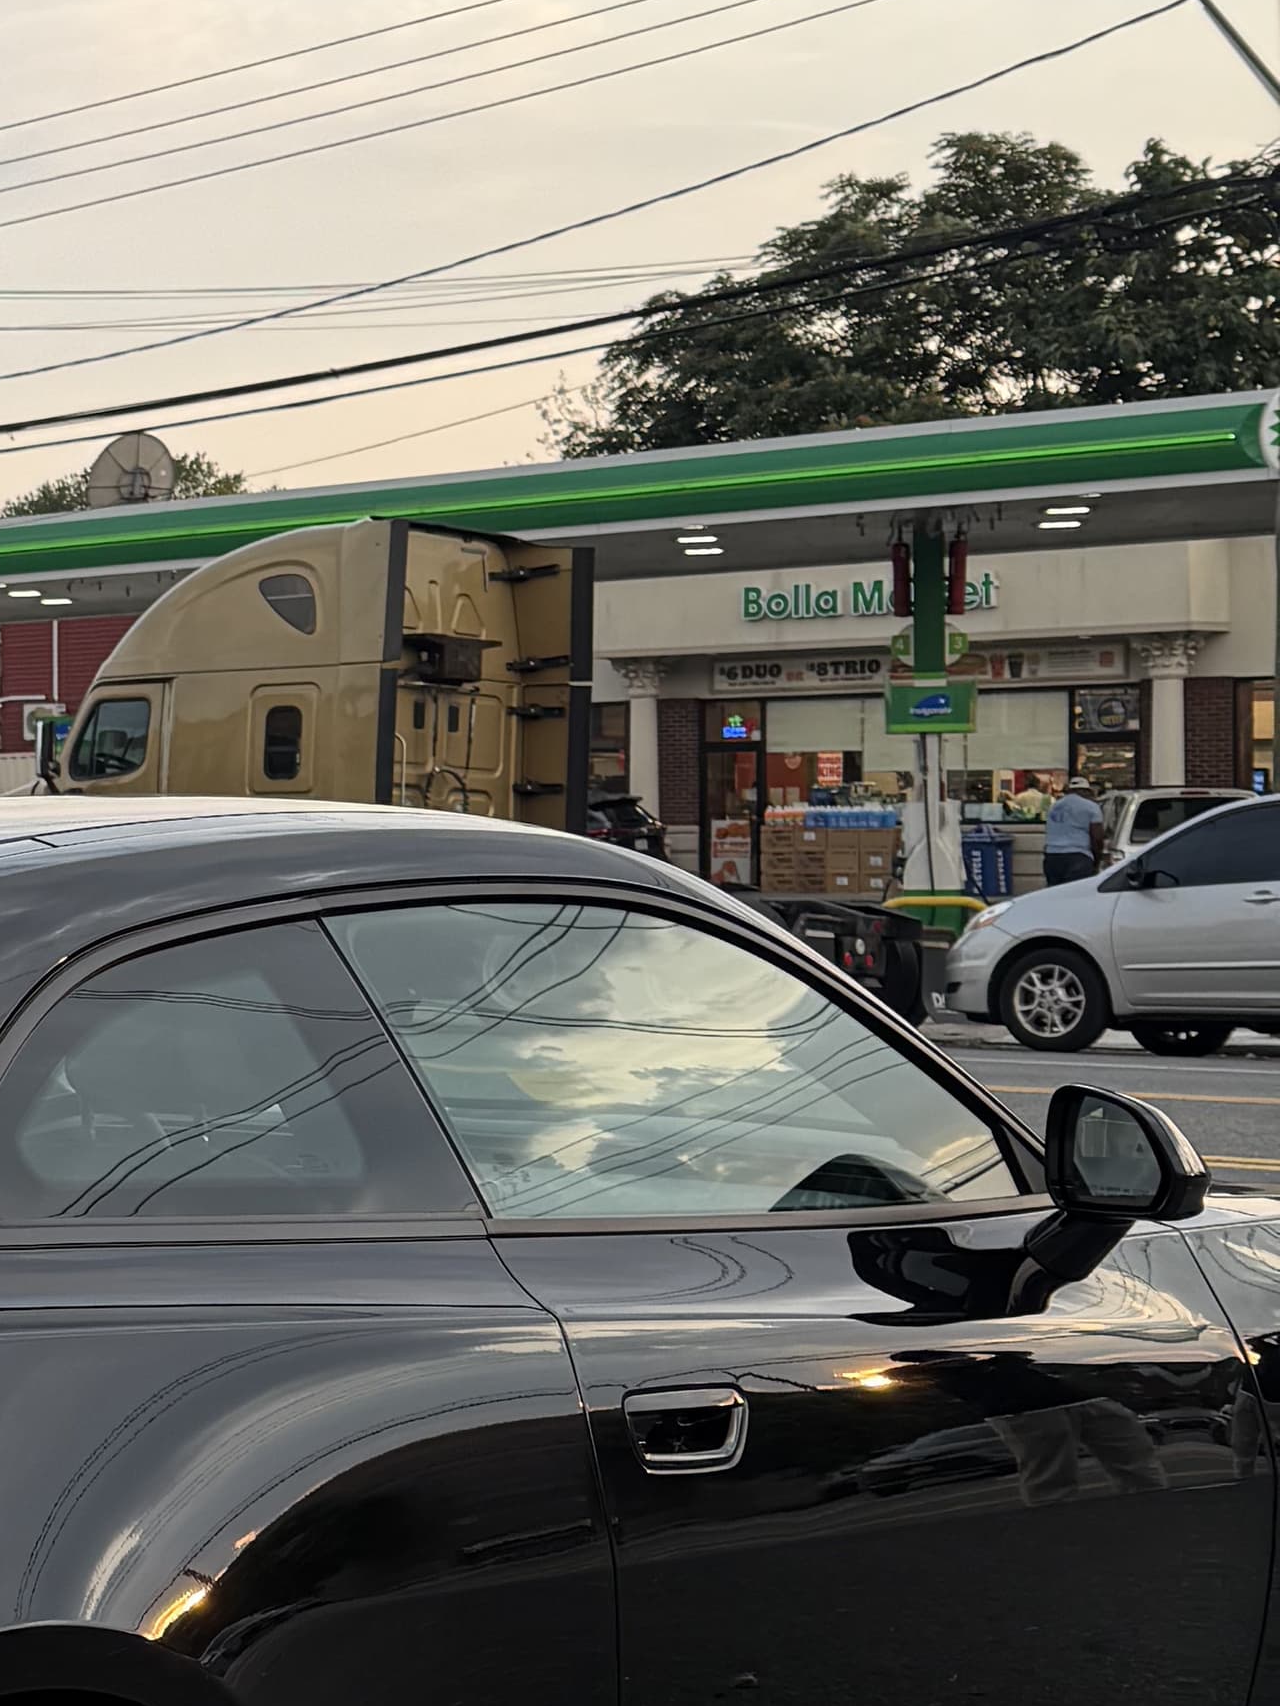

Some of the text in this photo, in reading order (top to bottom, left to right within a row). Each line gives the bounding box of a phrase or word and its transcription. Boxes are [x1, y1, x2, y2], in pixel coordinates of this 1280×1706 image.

[743, 572, 1000, 621] Bolla Met
[894, 635, 906, 650] 4
[952, 635, 964, 650] 3
[741, 663, 782, 680] DUO
[829, 659, 881, 675] TRIO
